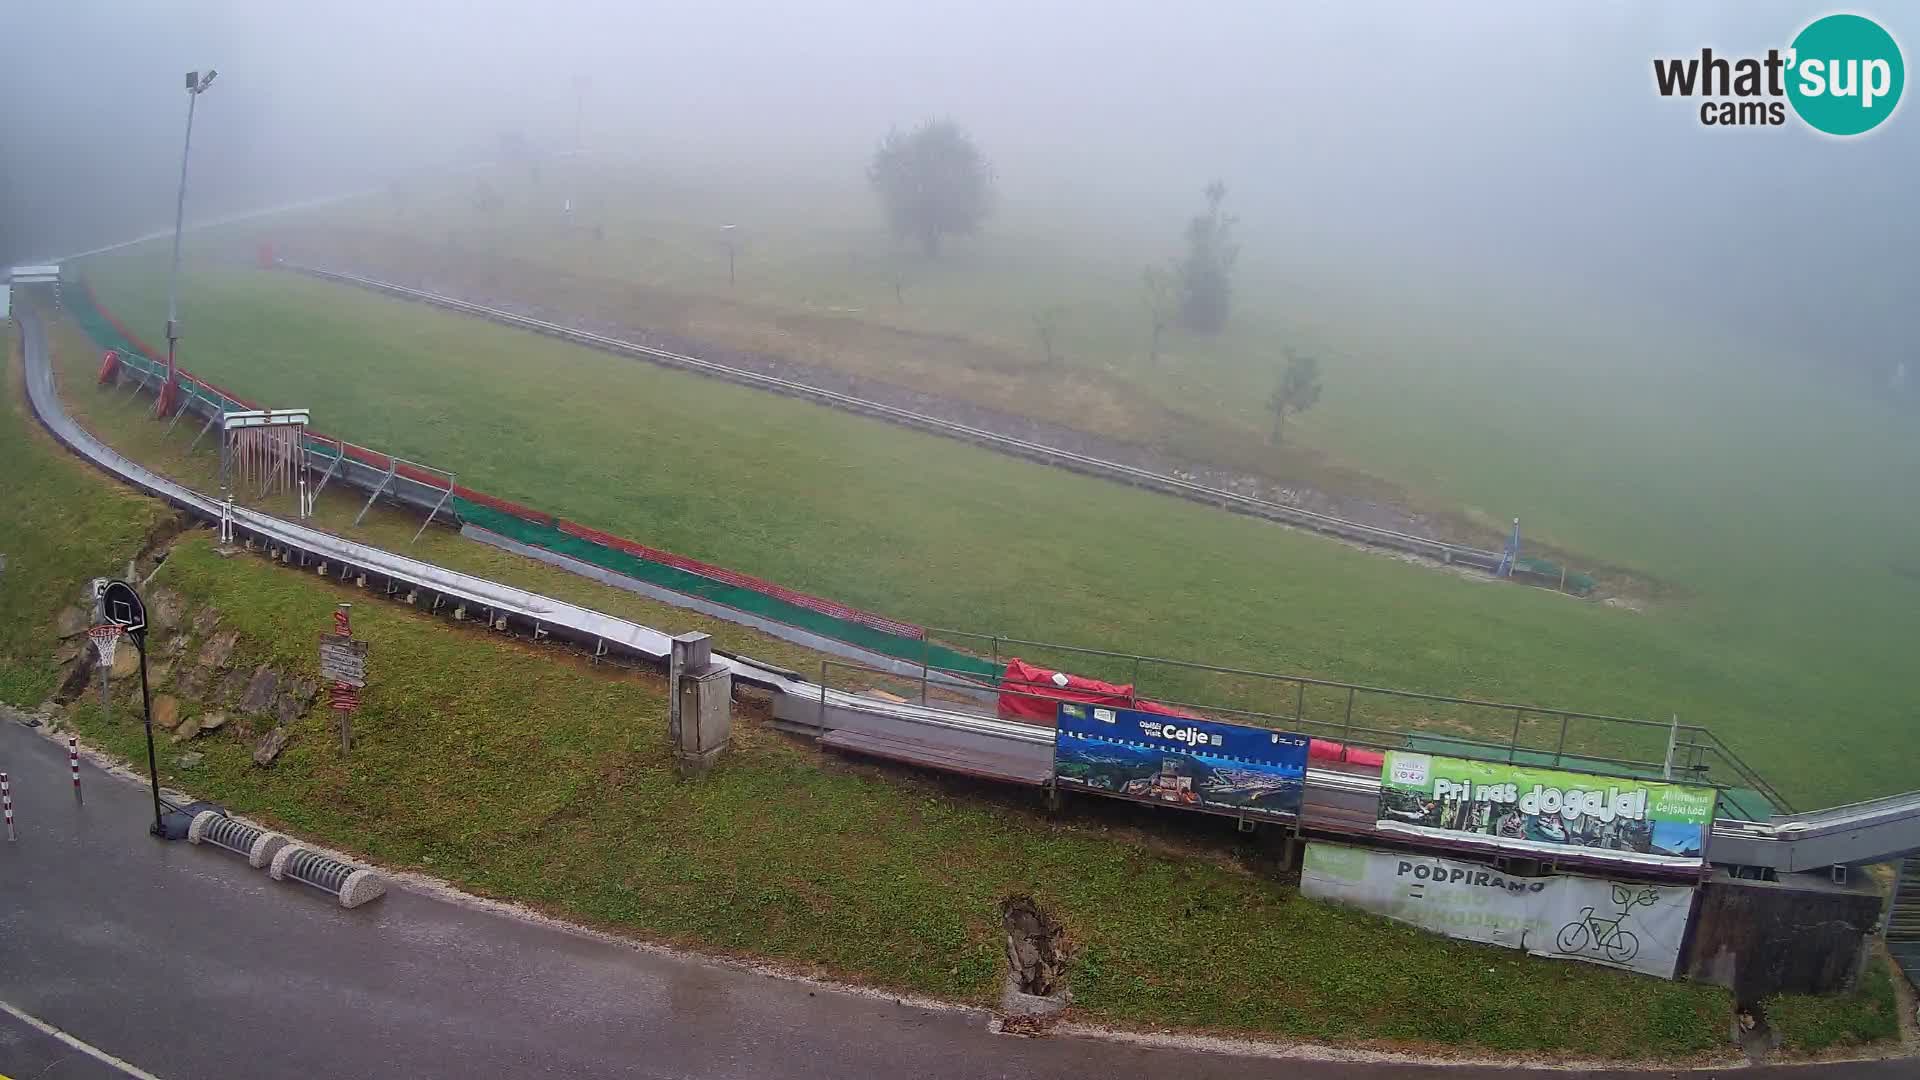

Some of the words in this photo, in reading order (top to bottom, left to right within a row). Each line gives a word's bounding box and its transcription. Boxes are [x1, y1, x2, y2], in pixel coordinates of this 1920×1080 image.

[1162, 724, 1209, 746] Celje
[1433, 778, 1472, 801] Pri
[1475, 784, 1519, 803] nas
[1397, 861, 1545, 893] PODPIRAMO
